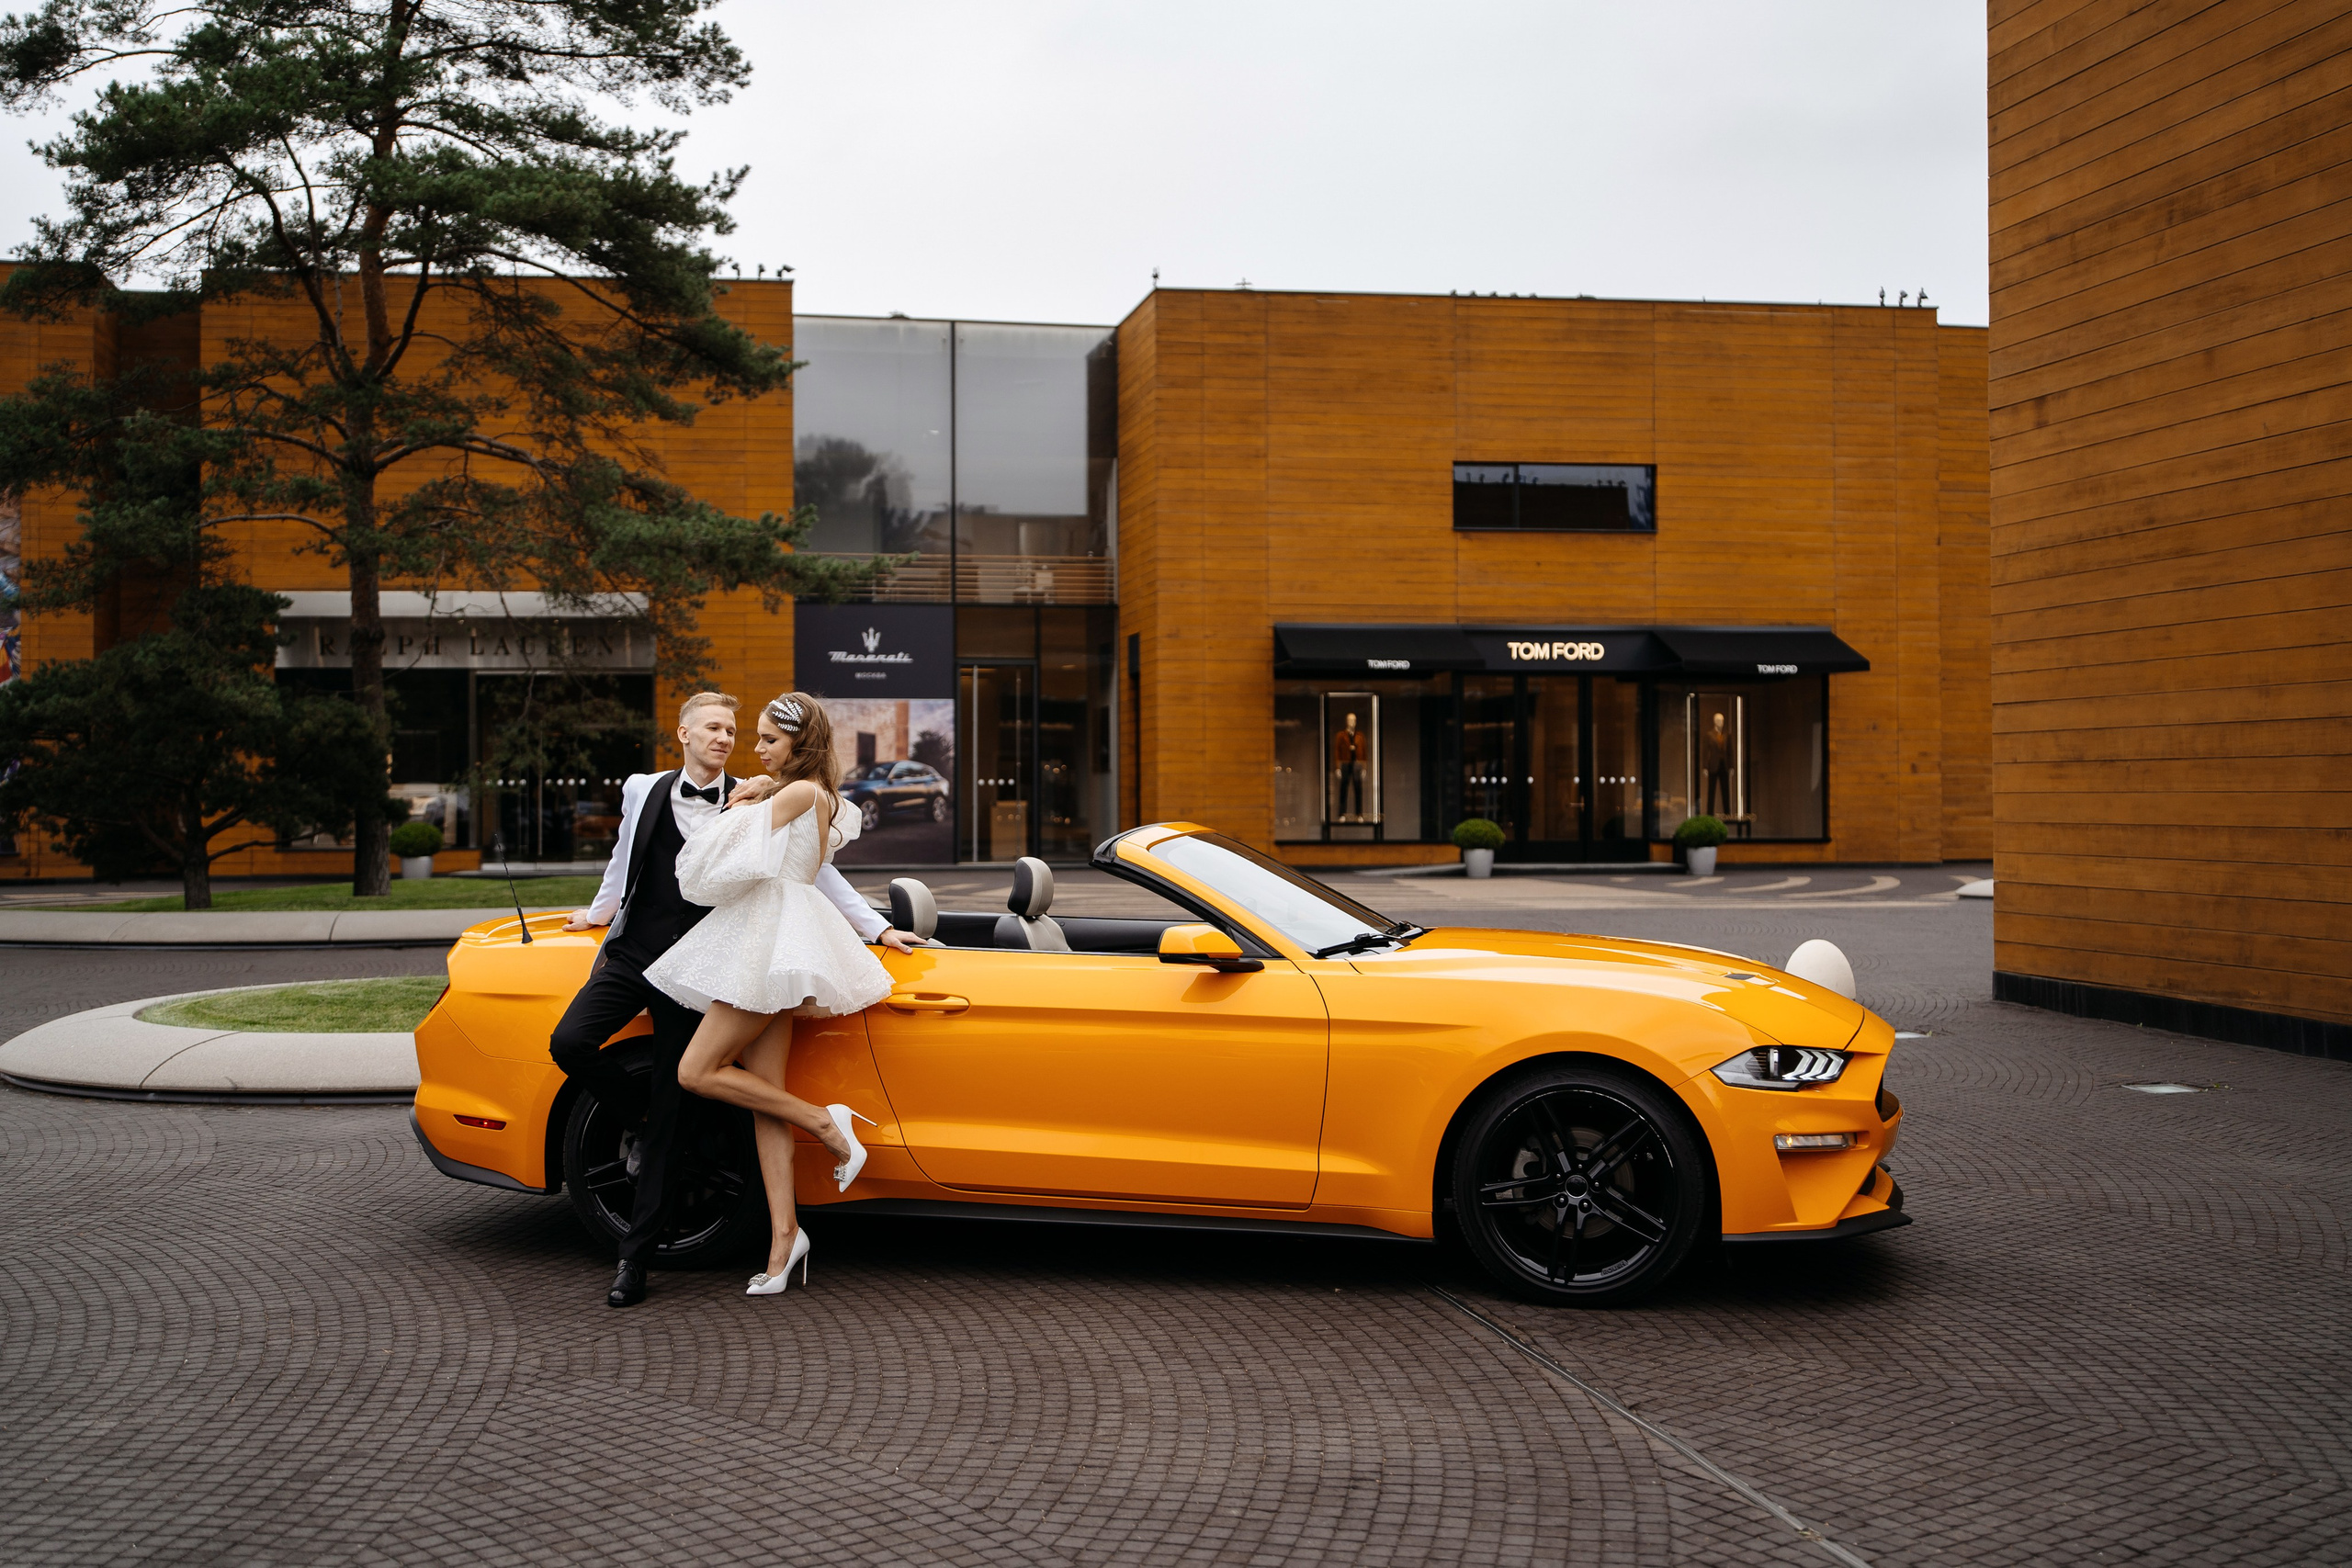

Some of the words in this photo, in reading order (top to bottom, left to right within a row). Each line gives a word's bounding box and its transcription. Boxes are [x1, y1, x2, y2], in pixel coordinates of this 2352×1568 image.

[320, 635, 442, 656] RPH
[1507, 642, 1550, 660] TOM
[1552, 642, 1605, 660] FORD
[828, 651, 914, 663] Maserati
[1366, 659, 1386, 670] TOM
[1387, 660, 1410, 670] FORD
[1757, 664, 1774, 674] TOM
[1775, 664, 1798, 674] FORD
